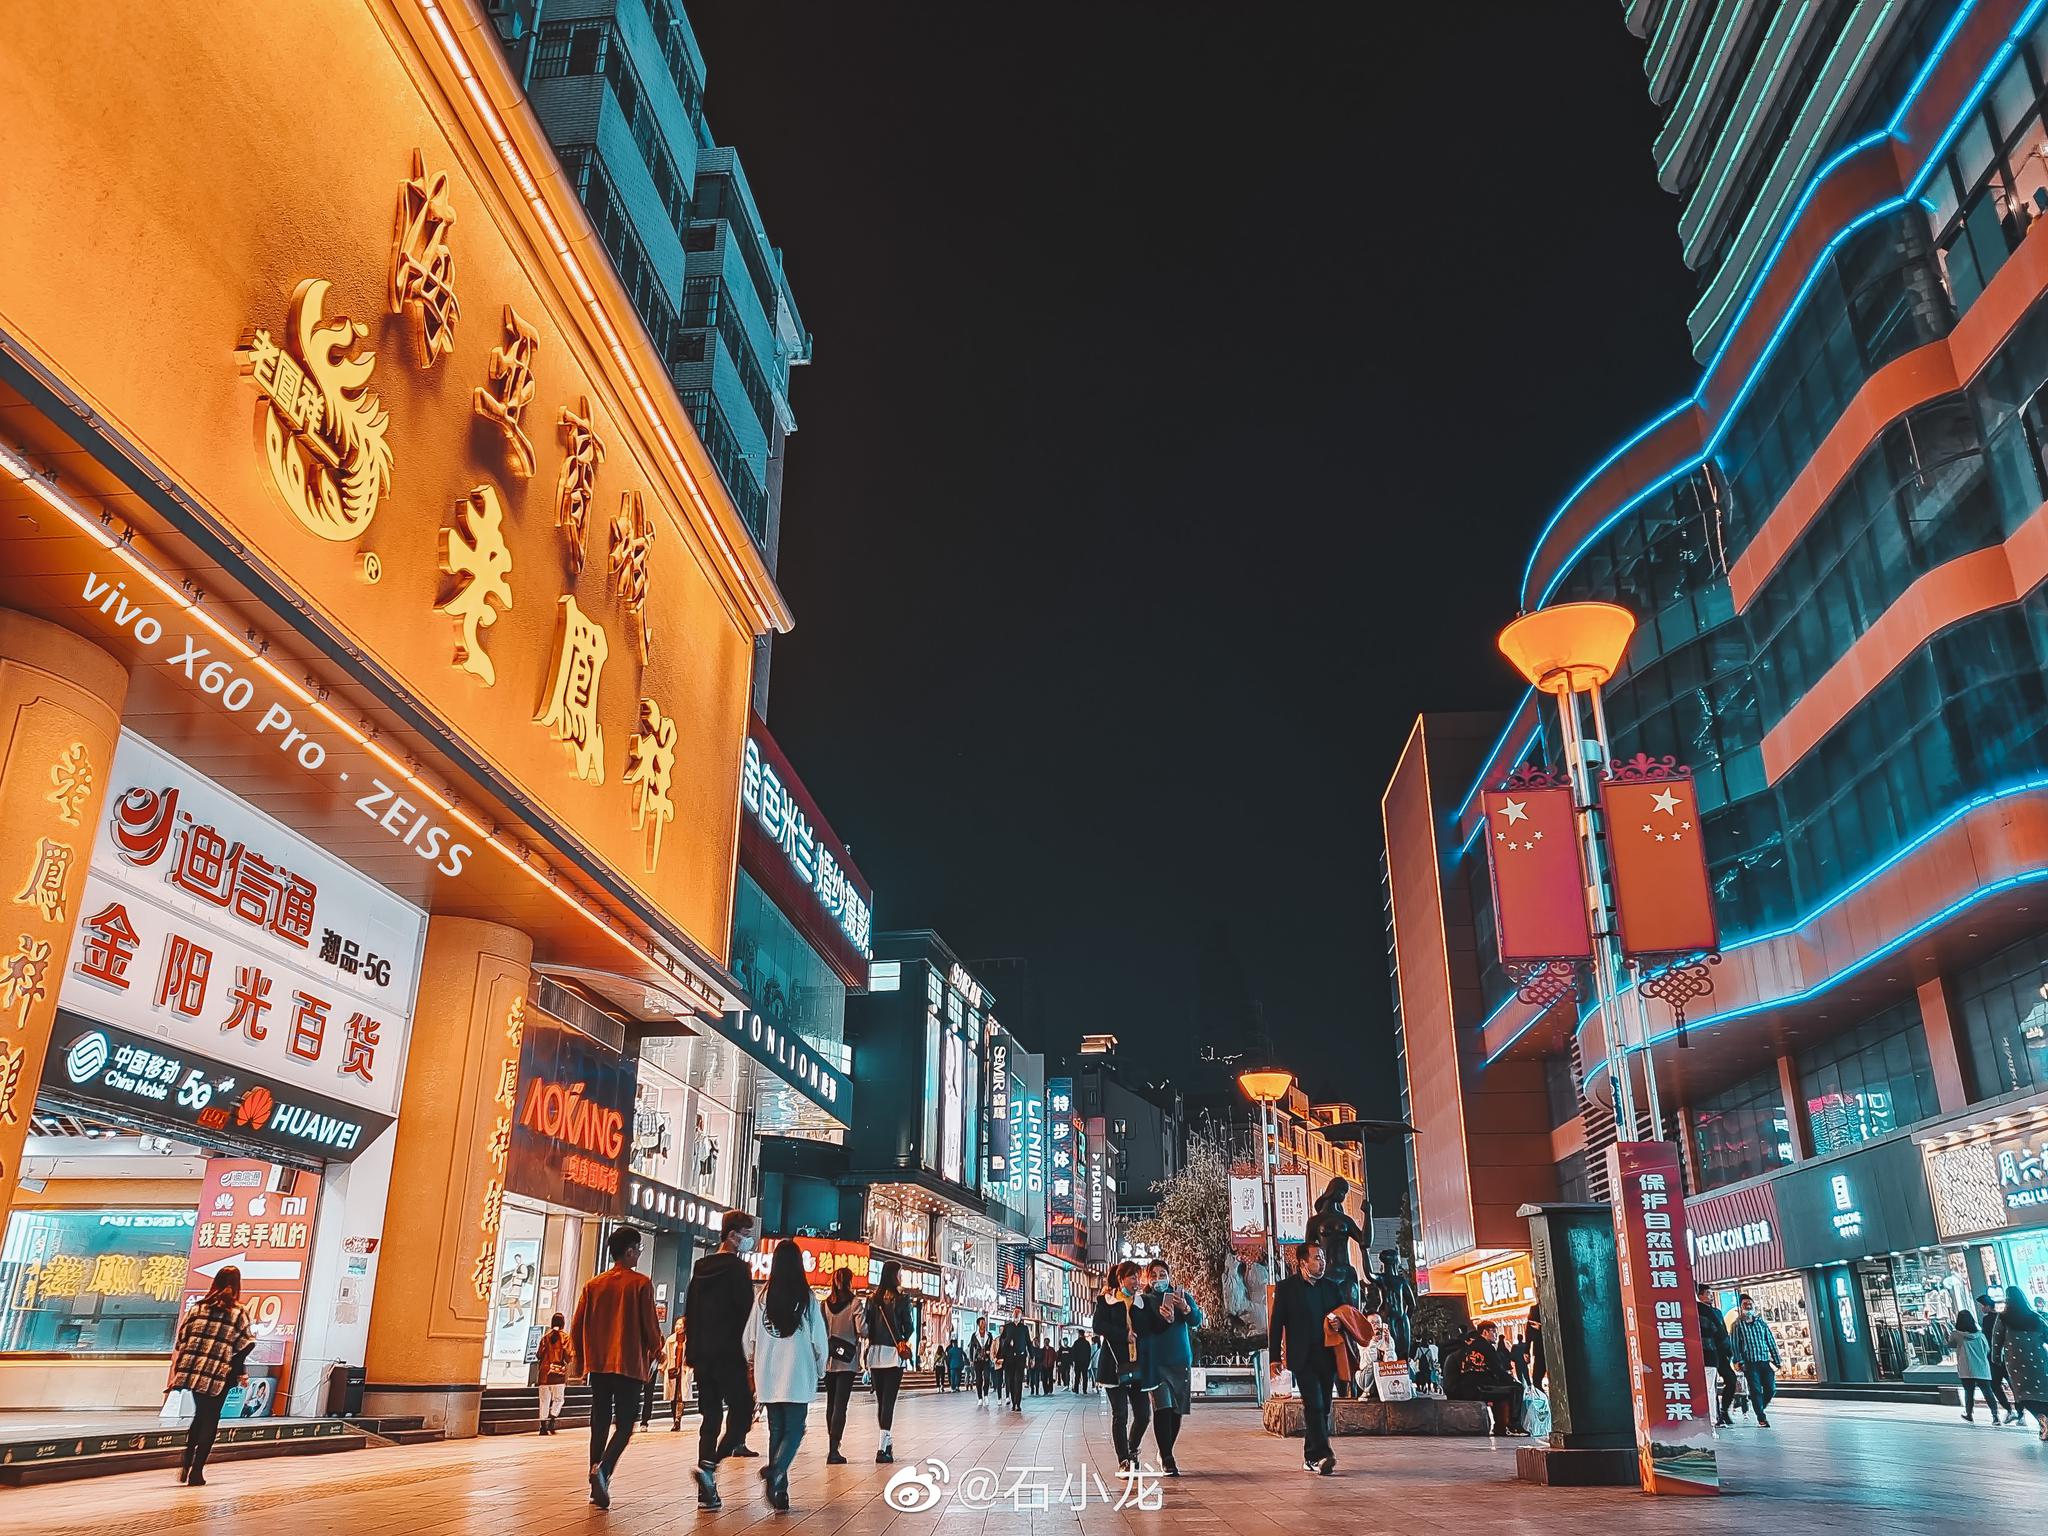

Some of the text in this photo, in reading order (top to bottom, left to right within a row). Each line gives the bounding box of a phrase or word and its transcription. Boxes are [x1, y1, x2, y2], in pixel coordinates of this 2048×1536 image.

[80, 572, 162, 645] vivo
[167, 634, 254, 712] X60
[256, 702, 326, 770] Pro
[355, 779, 472, 877] ZEISS
[165, 811, 317, 949] 迪信通
[74, 902, 383, 1083] 金阳光百货
[104, 1072, 167, 1102] China Mobile
[114, 1044, 179, 1085] 中国移动
[992, 1046, 1006, 1091] SEMIR
[271, 1105, 362, 1149] HUAWEI
[1026, 1100, 1041, 1193] LI-NING
[1053, 1095, 1070, 1197] 特步体育
[631, 1183, 706, 1226] TONLION
[198, 1223, 306, 1248] 我是卖手机的
[1695, 1227, 1744, 1257] YEARCON
[1639, 1174, 1693, 1421] 保护自然环境 创造美好未来
